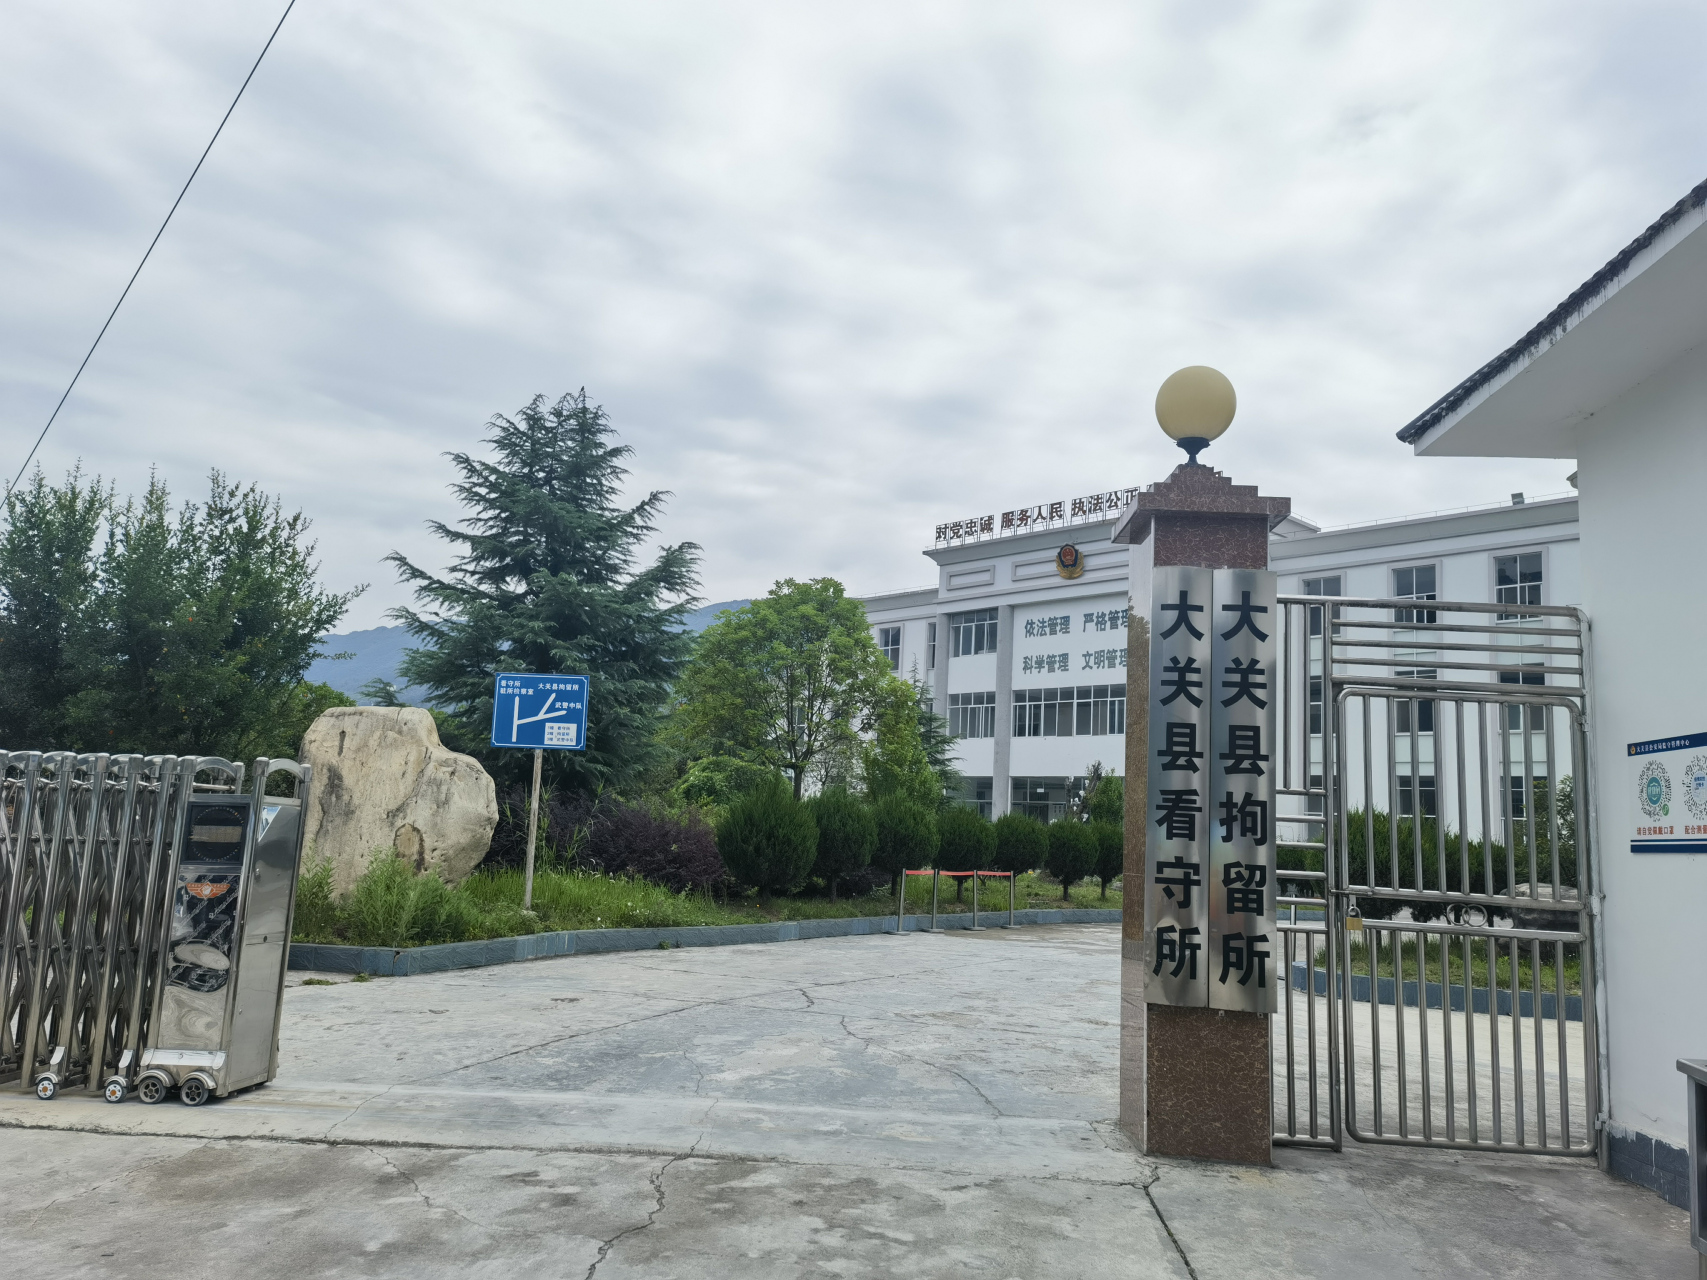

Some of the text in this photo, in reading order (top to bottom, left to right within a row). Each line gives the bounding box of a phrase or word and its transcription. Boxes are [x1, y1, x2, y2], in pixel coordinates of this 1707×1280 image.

[935, 488, 1138, 541] 对党忠诚 服务人民 执法公正
[1024, 615, 1071, 639] 依法管理
[1022, 652, 1070, 675] 科学管理
[538, 683, 579, 691] 大关县拘留所
[1153, 590, 1205, 980] 大关县看守所
[1219, 590, 1271, 989] 大关县拘留所
